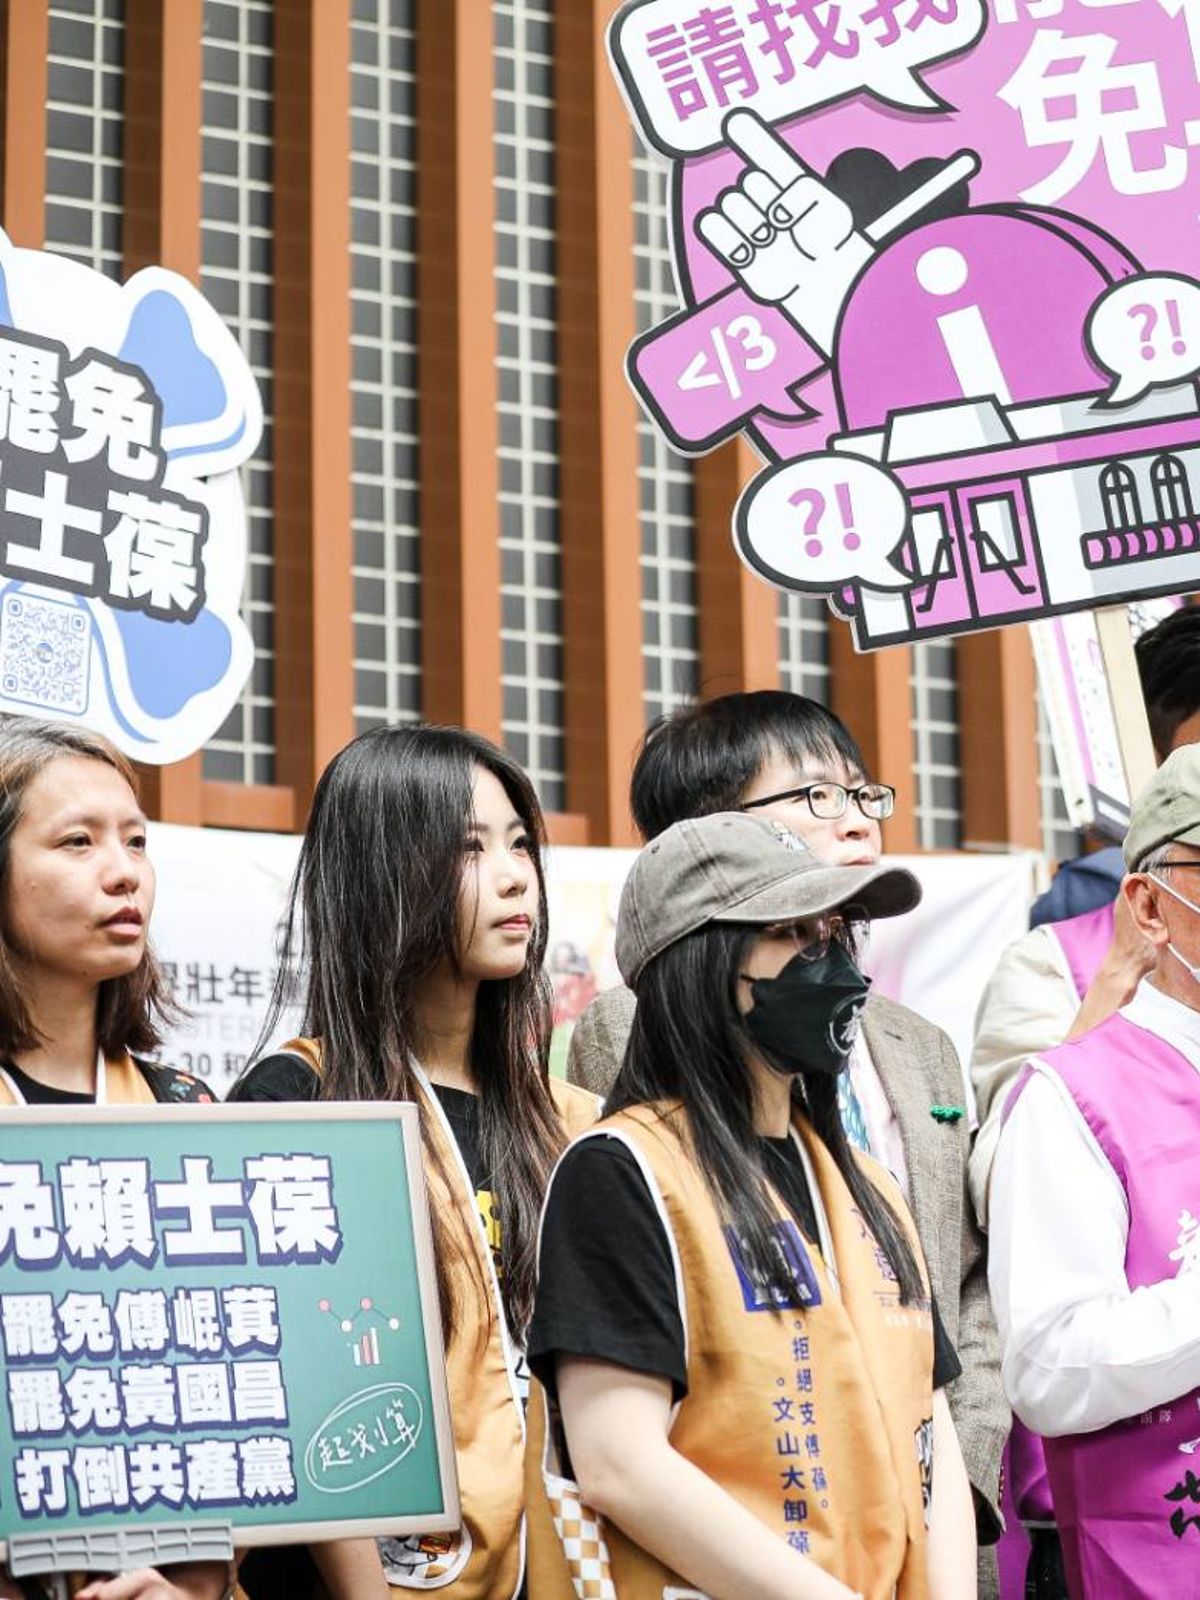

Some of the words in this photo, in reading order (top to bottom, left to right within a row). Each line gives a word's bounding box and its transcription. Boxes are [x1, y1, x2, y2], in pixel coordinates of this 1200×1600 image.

[995, 0, 1188, 206] 免
[8, 1360, 288, 1433] 罷免黃國昌
[15, 1436, 297, 1511] 打倒共產黨
